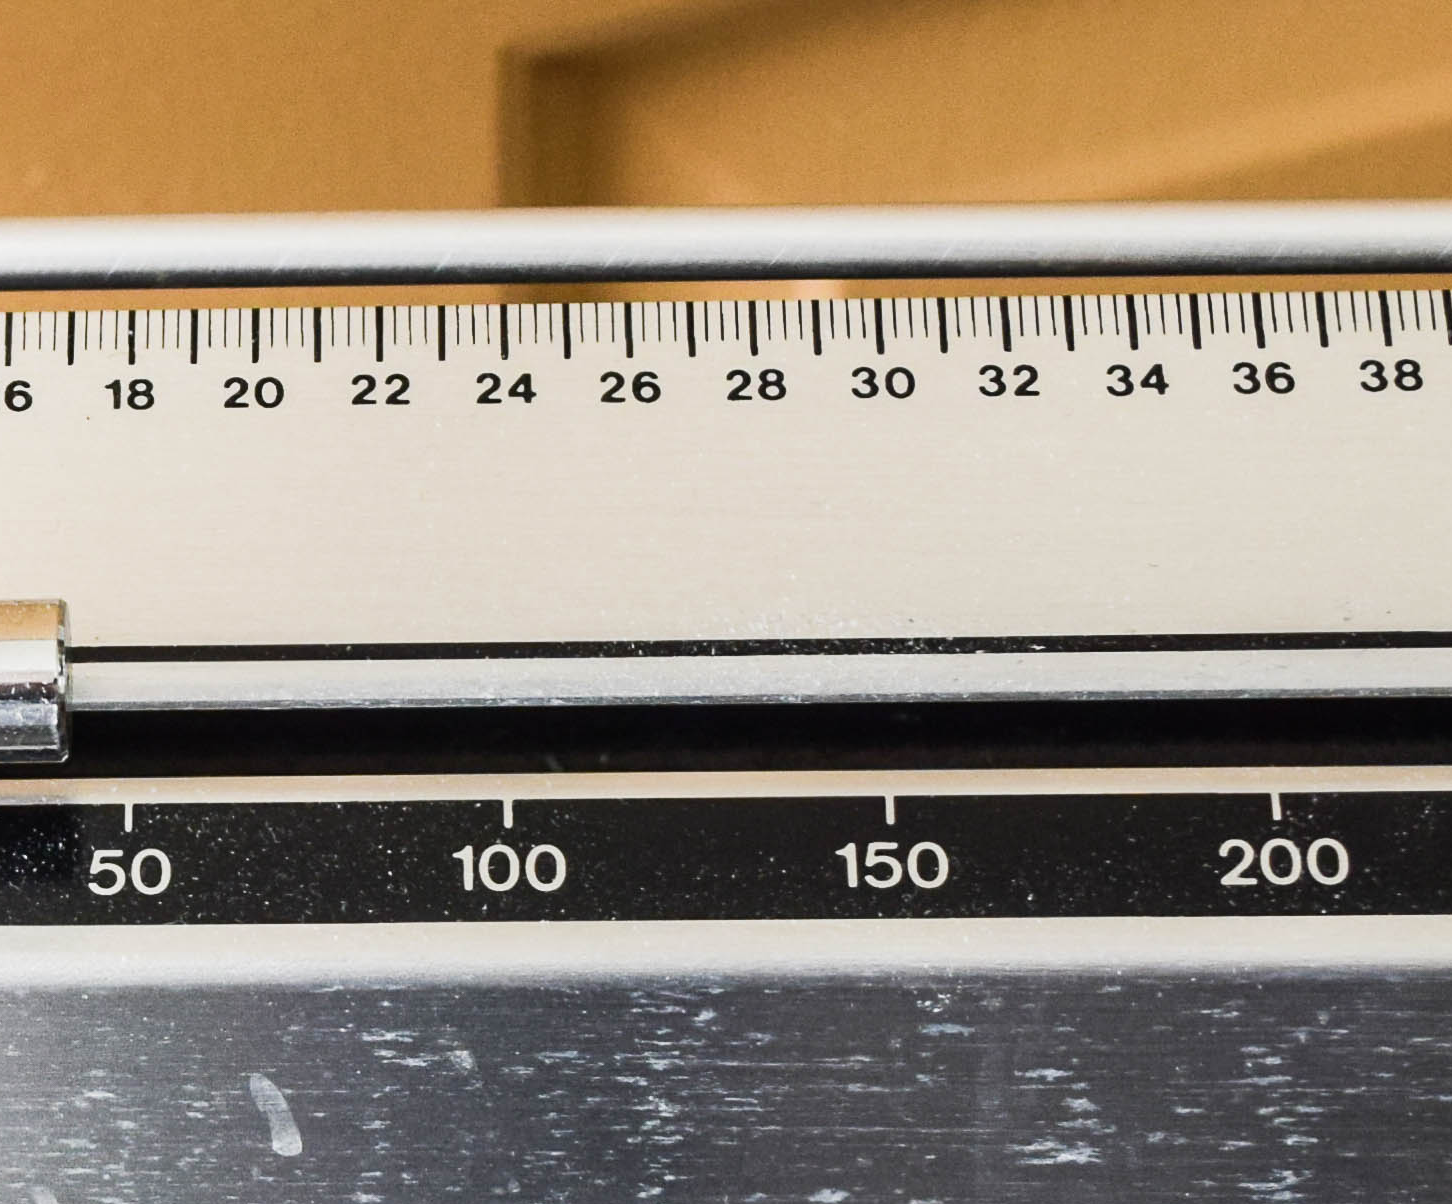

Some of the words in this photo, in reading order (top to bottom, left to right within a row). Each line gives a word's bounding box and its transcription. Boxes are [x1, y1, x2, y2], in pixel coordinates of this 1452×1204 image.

[103, 377, 156, 412] 18
[222, 375, 286, 410] 20
[350, 372, 412, 407] 22
[475, 371, 538, 406] 24
[598, 369, 663, 405] 26
[725, 367, 788, 403] 28
[850, 365, 917, 401] 30
[977, 363, 1042, 398] 32
[1105, 362, 1171, 398] 34
[1231, 360, 1297, 396] 36
[1358, 357, 1425, 394] 38
[86, 847, 173, 897] 50
[450, 842, 568, 894] 100
[833, 840, 950, 890] 150
[1217, 836, 1351, 887] 200
